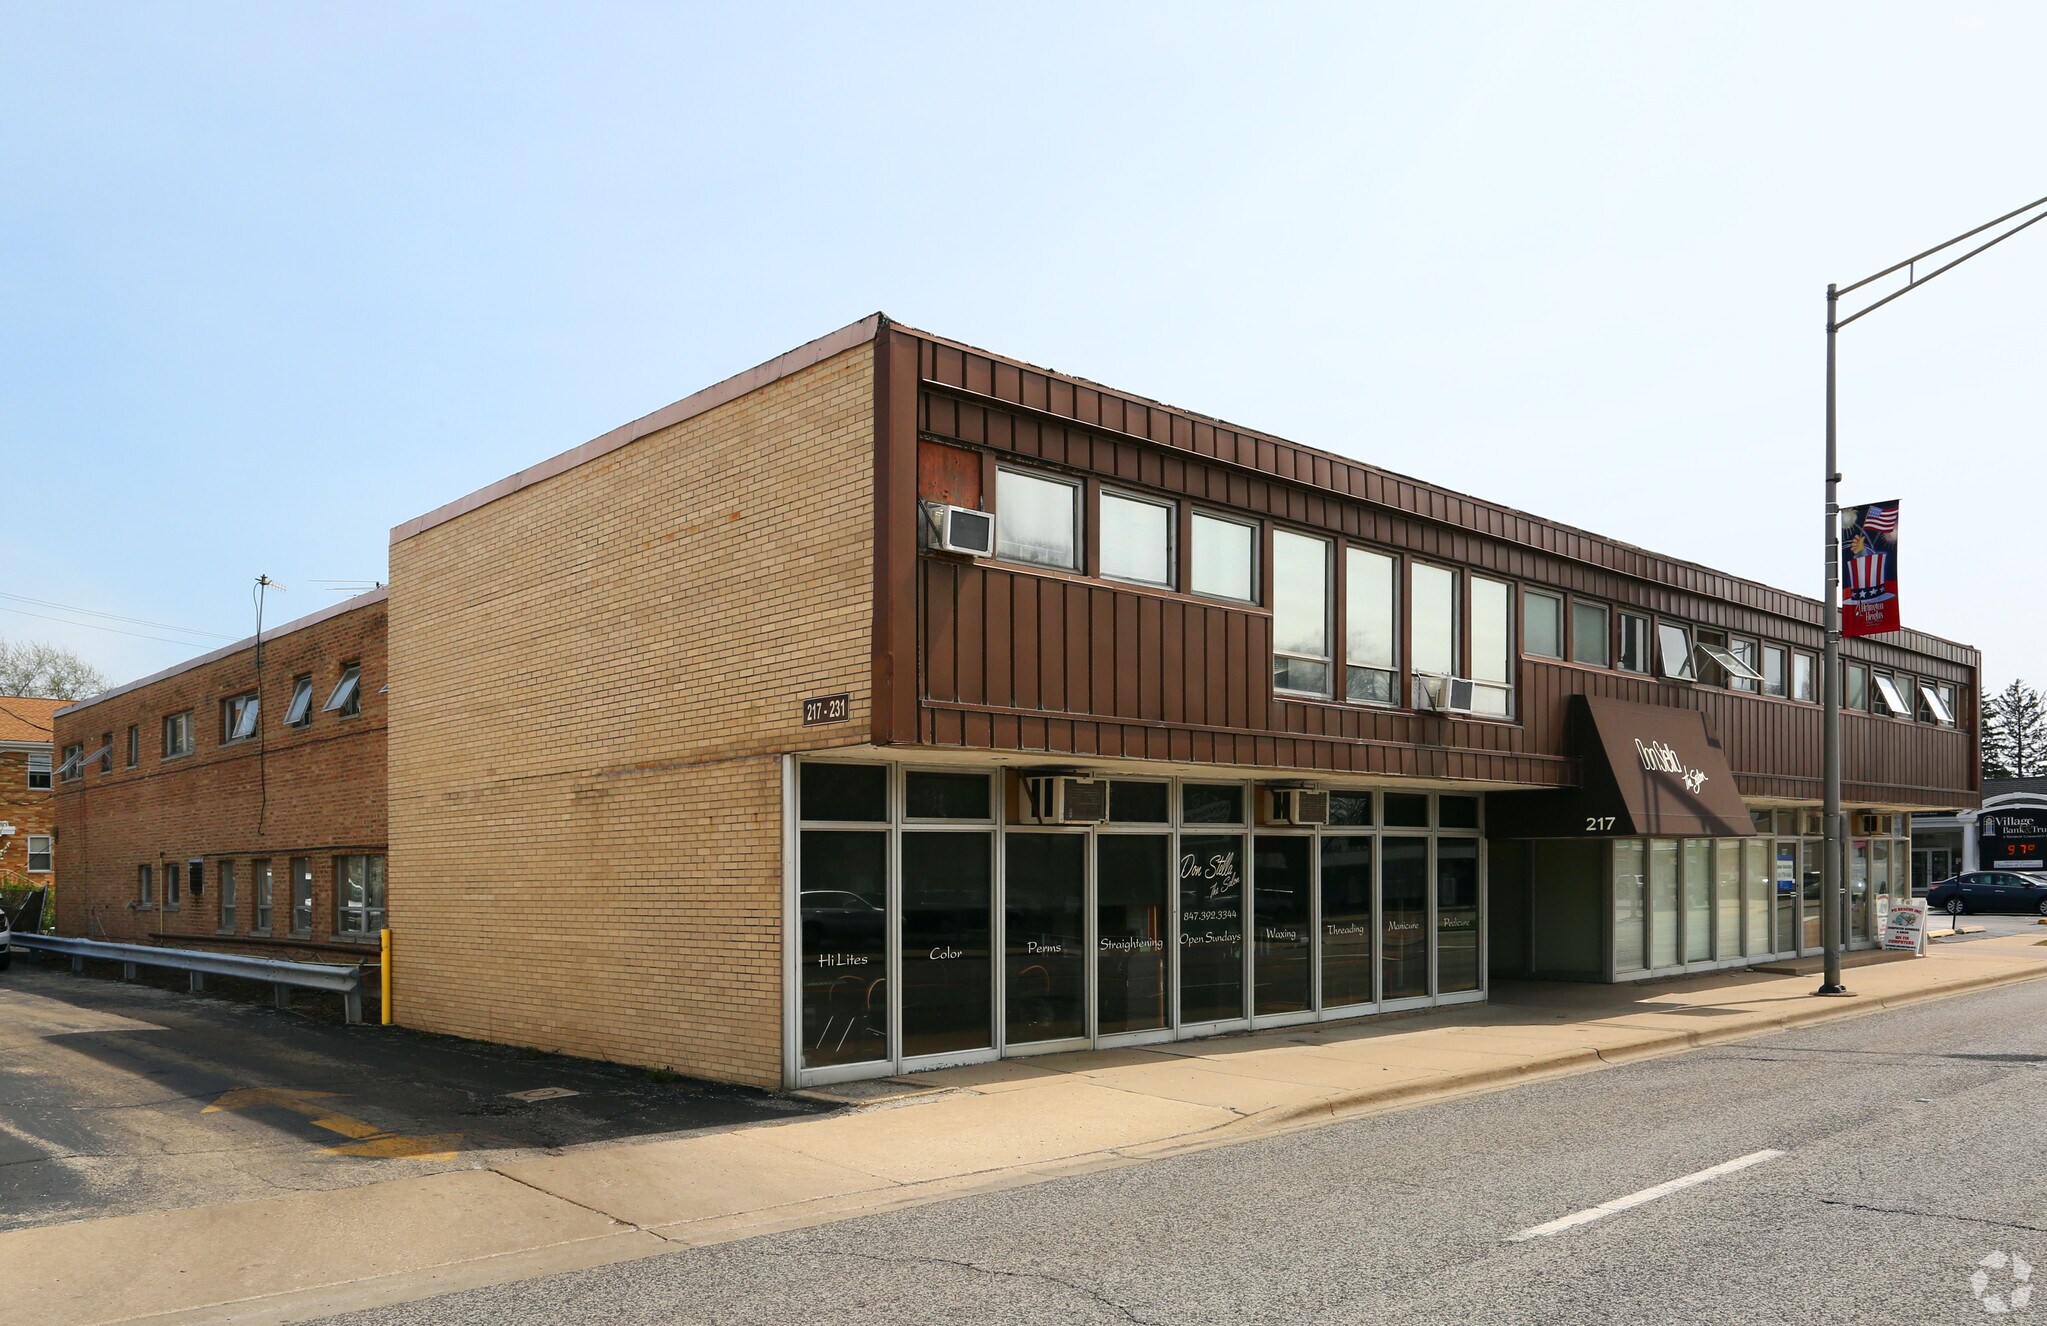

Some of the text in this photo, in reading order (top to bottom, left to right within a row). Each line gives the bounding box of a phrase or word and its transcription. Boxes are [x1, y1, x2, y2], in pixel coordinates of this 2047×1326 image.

[807, 702, 822, 720] 217
[829, 699, 845, 717] 231
[1586, 816, 1616, 831] 217
[1995, 817, 2034, 827] Village
[2003, 826, 2024, 834] Bank
[1180, 852, 1234, 879] Don Stella
[1210, 872, 1240, 899] The Salon
[1184, 910, 1237, 921] 847.392.3344
[1443, 917, 1470, 927] Pedicure
[1327, 923, 1364, 936] Threading
[1388, 920, 1419, 932] Manicure
[1179, 930, 1241, 947] Open Sundays
[1266, 928, 1297, 941] Waxing
[1027, 941, 1062, 953] Perms
[1100, 936, 1163, 952] Straightening
[929, 946, 963, 960] Color
